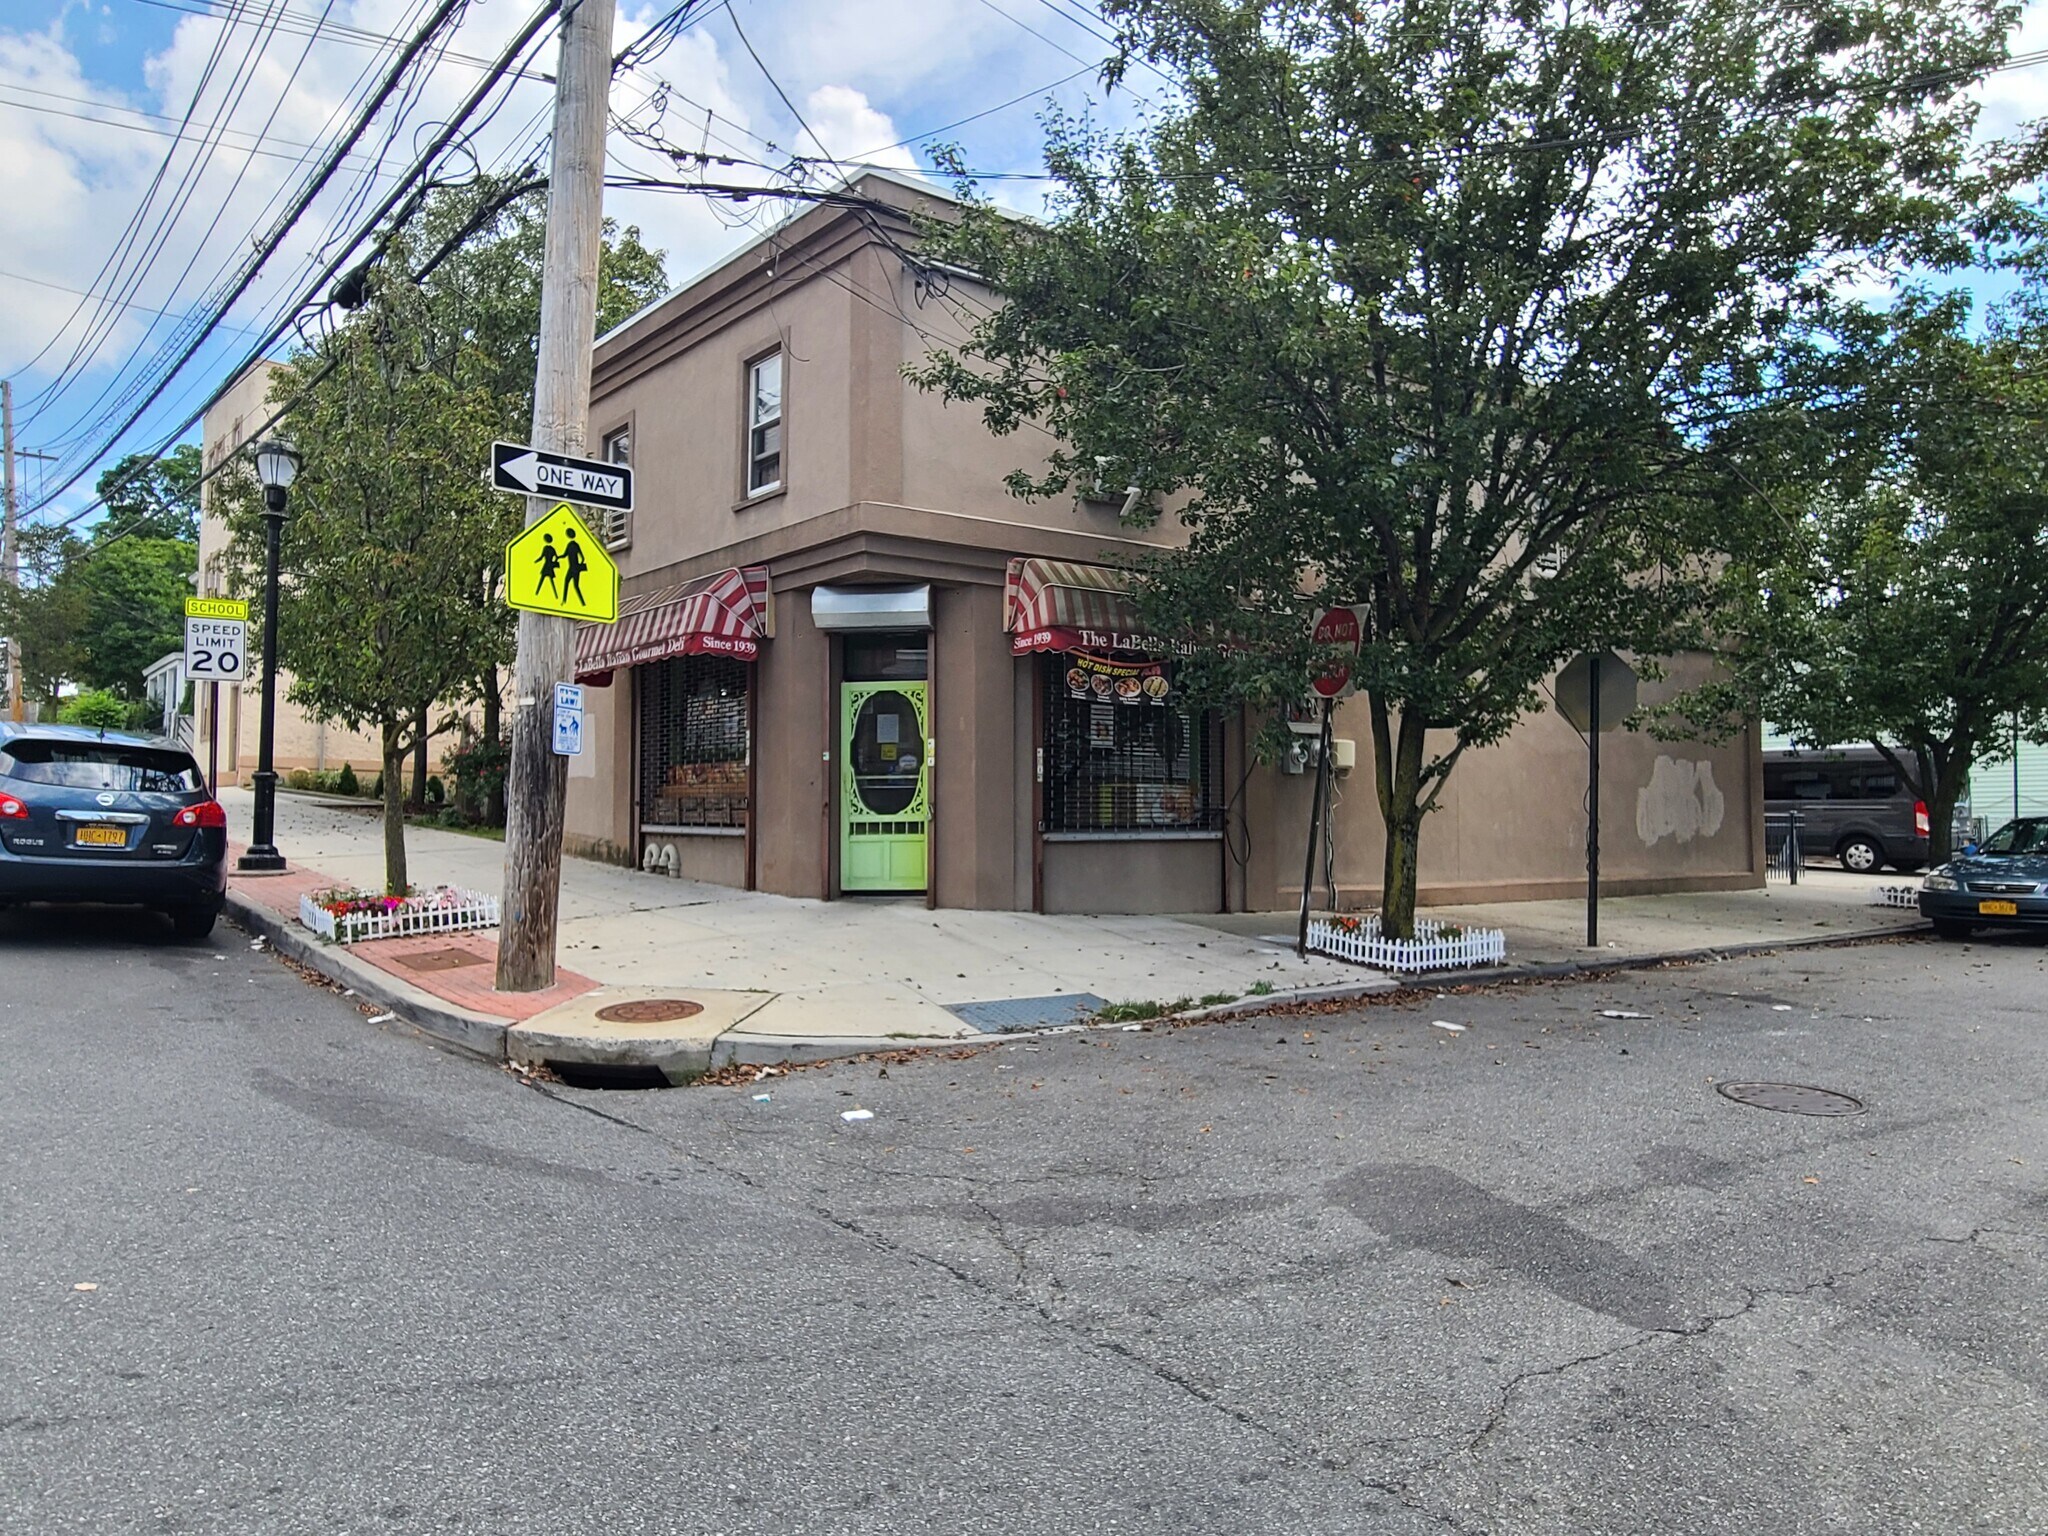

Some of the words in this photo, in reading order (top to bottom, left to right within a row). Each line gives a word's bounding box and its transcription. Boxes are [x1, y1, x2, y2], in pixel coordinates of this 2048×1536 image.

[537, 465, 574, 487] ONE
[581, 473, 618, 495] WAY
[190, 602, 243, 615] SCHOOL
[191, 623, 241, 636] SPEED
[1334, 622, 1355, 639] NOT
[196, 636, 235, 648] LIMIT
[702, 636, 732, 651] Since
[734, 640, 757, 654] 1939
[1013, 635, 1033, 648] Since
[1033, 632, 1052, 645] 1939
[1078, 630, 1109, 647] The
[606, 651, 631, 667] Italian
[631, 644, 665, 662] Gourmet
[666, 637, 686, 654] Deli
[191, 650, 239, 673] 20
[1077, 657, 1094, 670] HOT
[1093, 663, 1113, 675] DISH
[1111, 667, 1140, 677] SPECIAL
